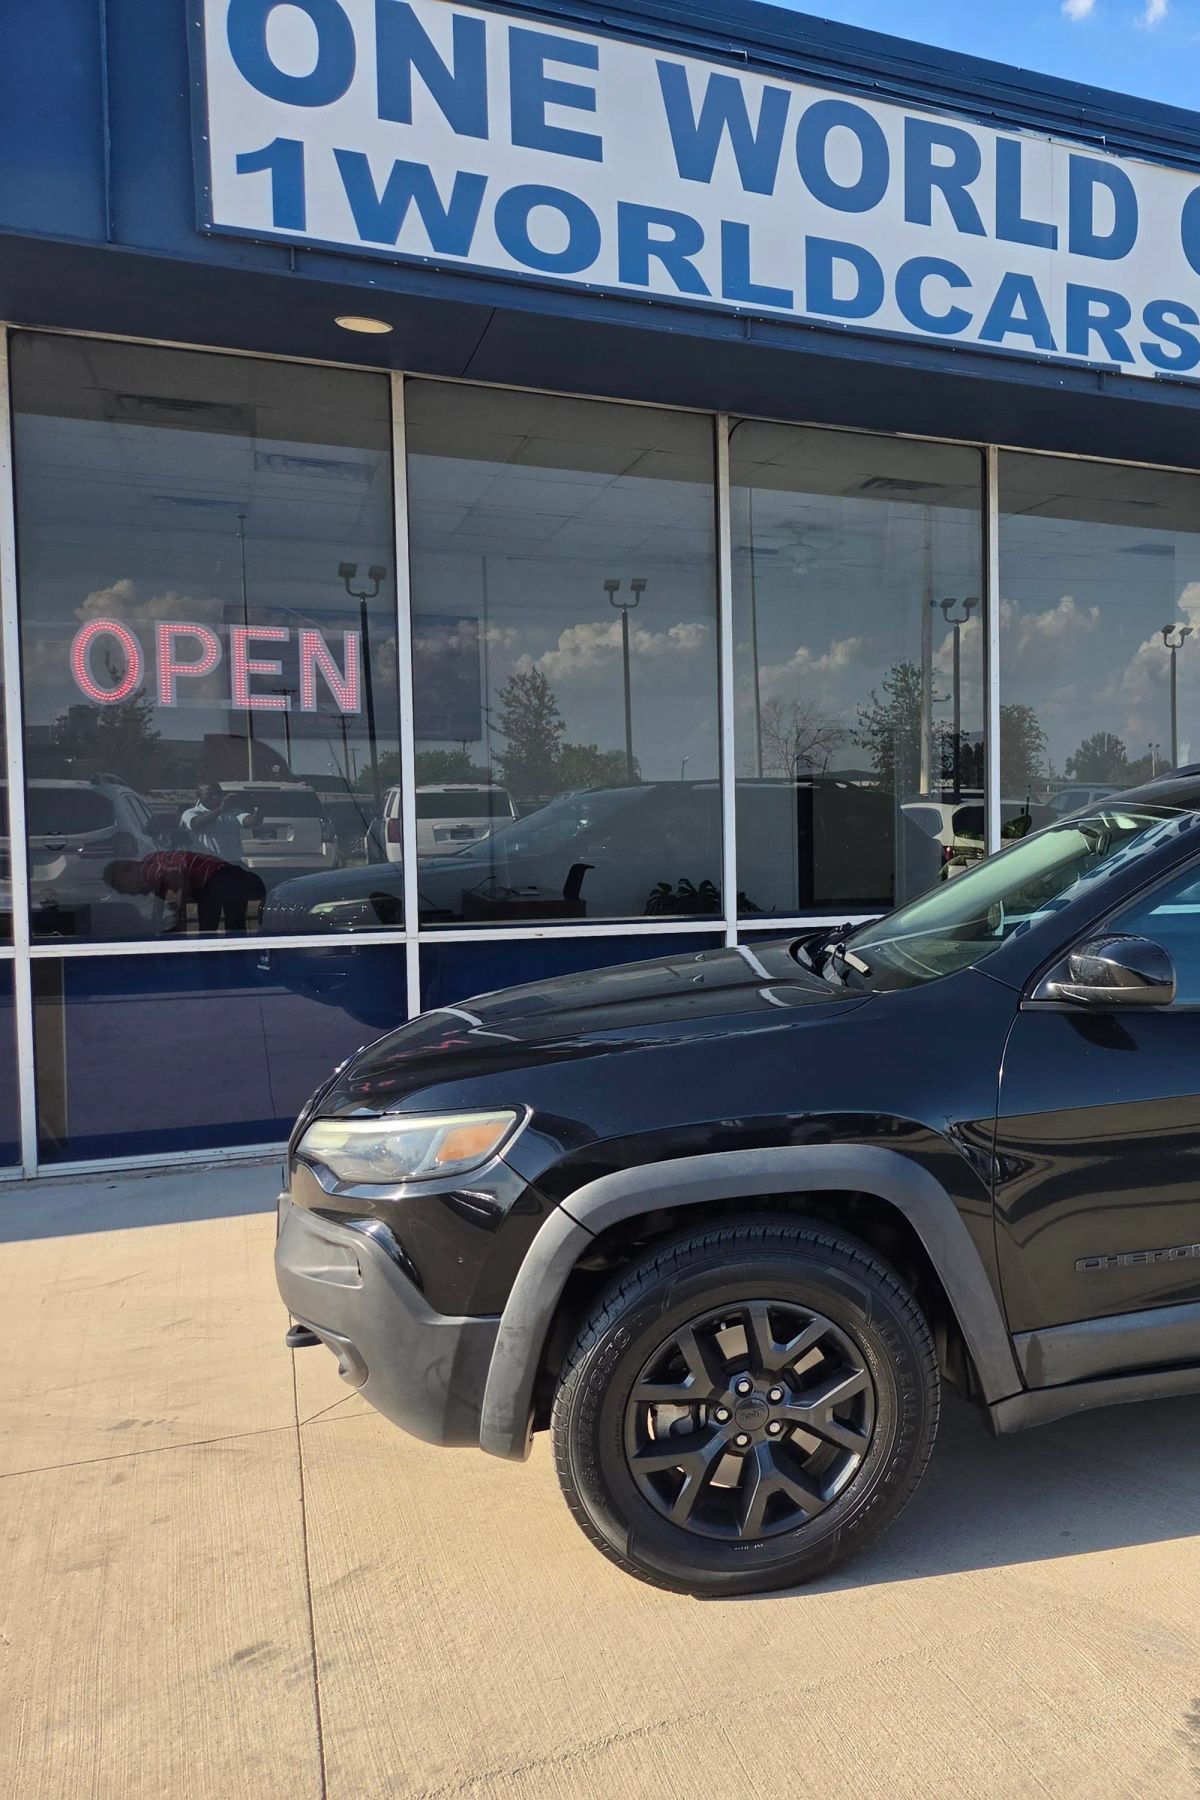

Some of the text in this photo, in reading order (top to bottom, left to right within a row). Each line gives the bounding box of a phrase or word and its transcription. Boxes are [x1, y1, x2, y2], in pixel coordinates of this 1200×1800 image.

[227, 0, 603, 162] ONE
[655, 59, 1139, 260] WORLD
[70, 617, 361, 714] OPEN
